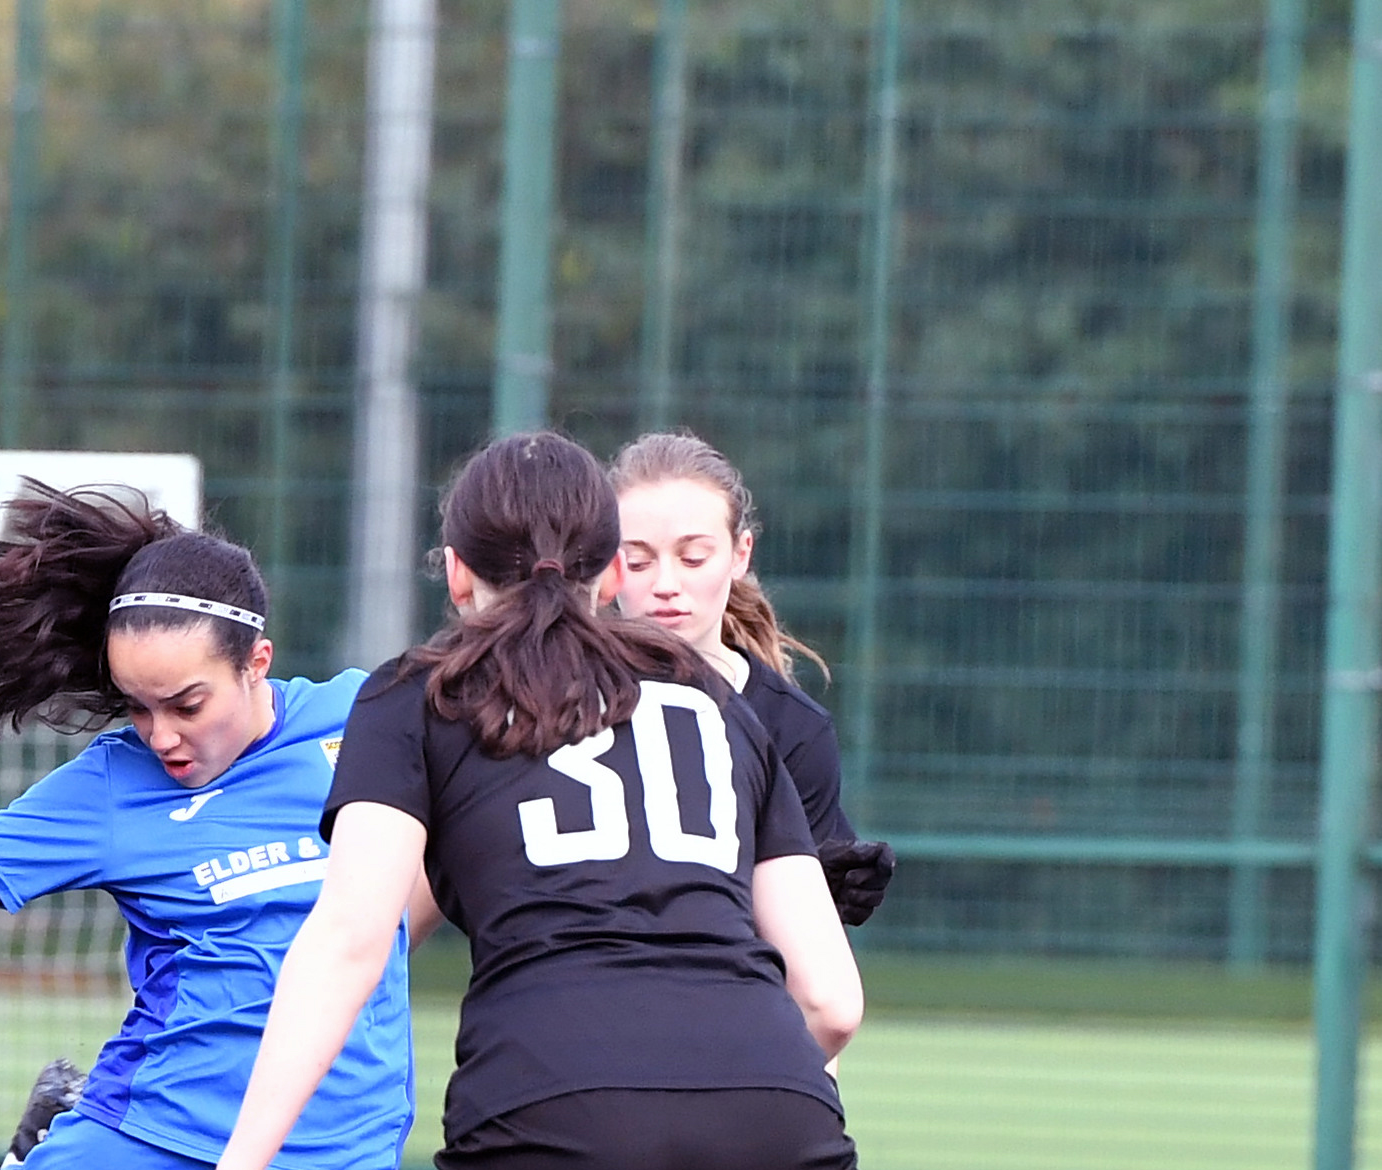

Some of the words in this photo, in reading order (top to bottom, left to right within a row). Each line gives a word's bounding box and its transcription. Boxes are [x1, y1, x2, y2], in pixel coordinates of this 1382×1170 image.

[517, 680, 740, 874] 30
[192, 842, 290, 886] ELDER
[298, 837, 321, 859] &
